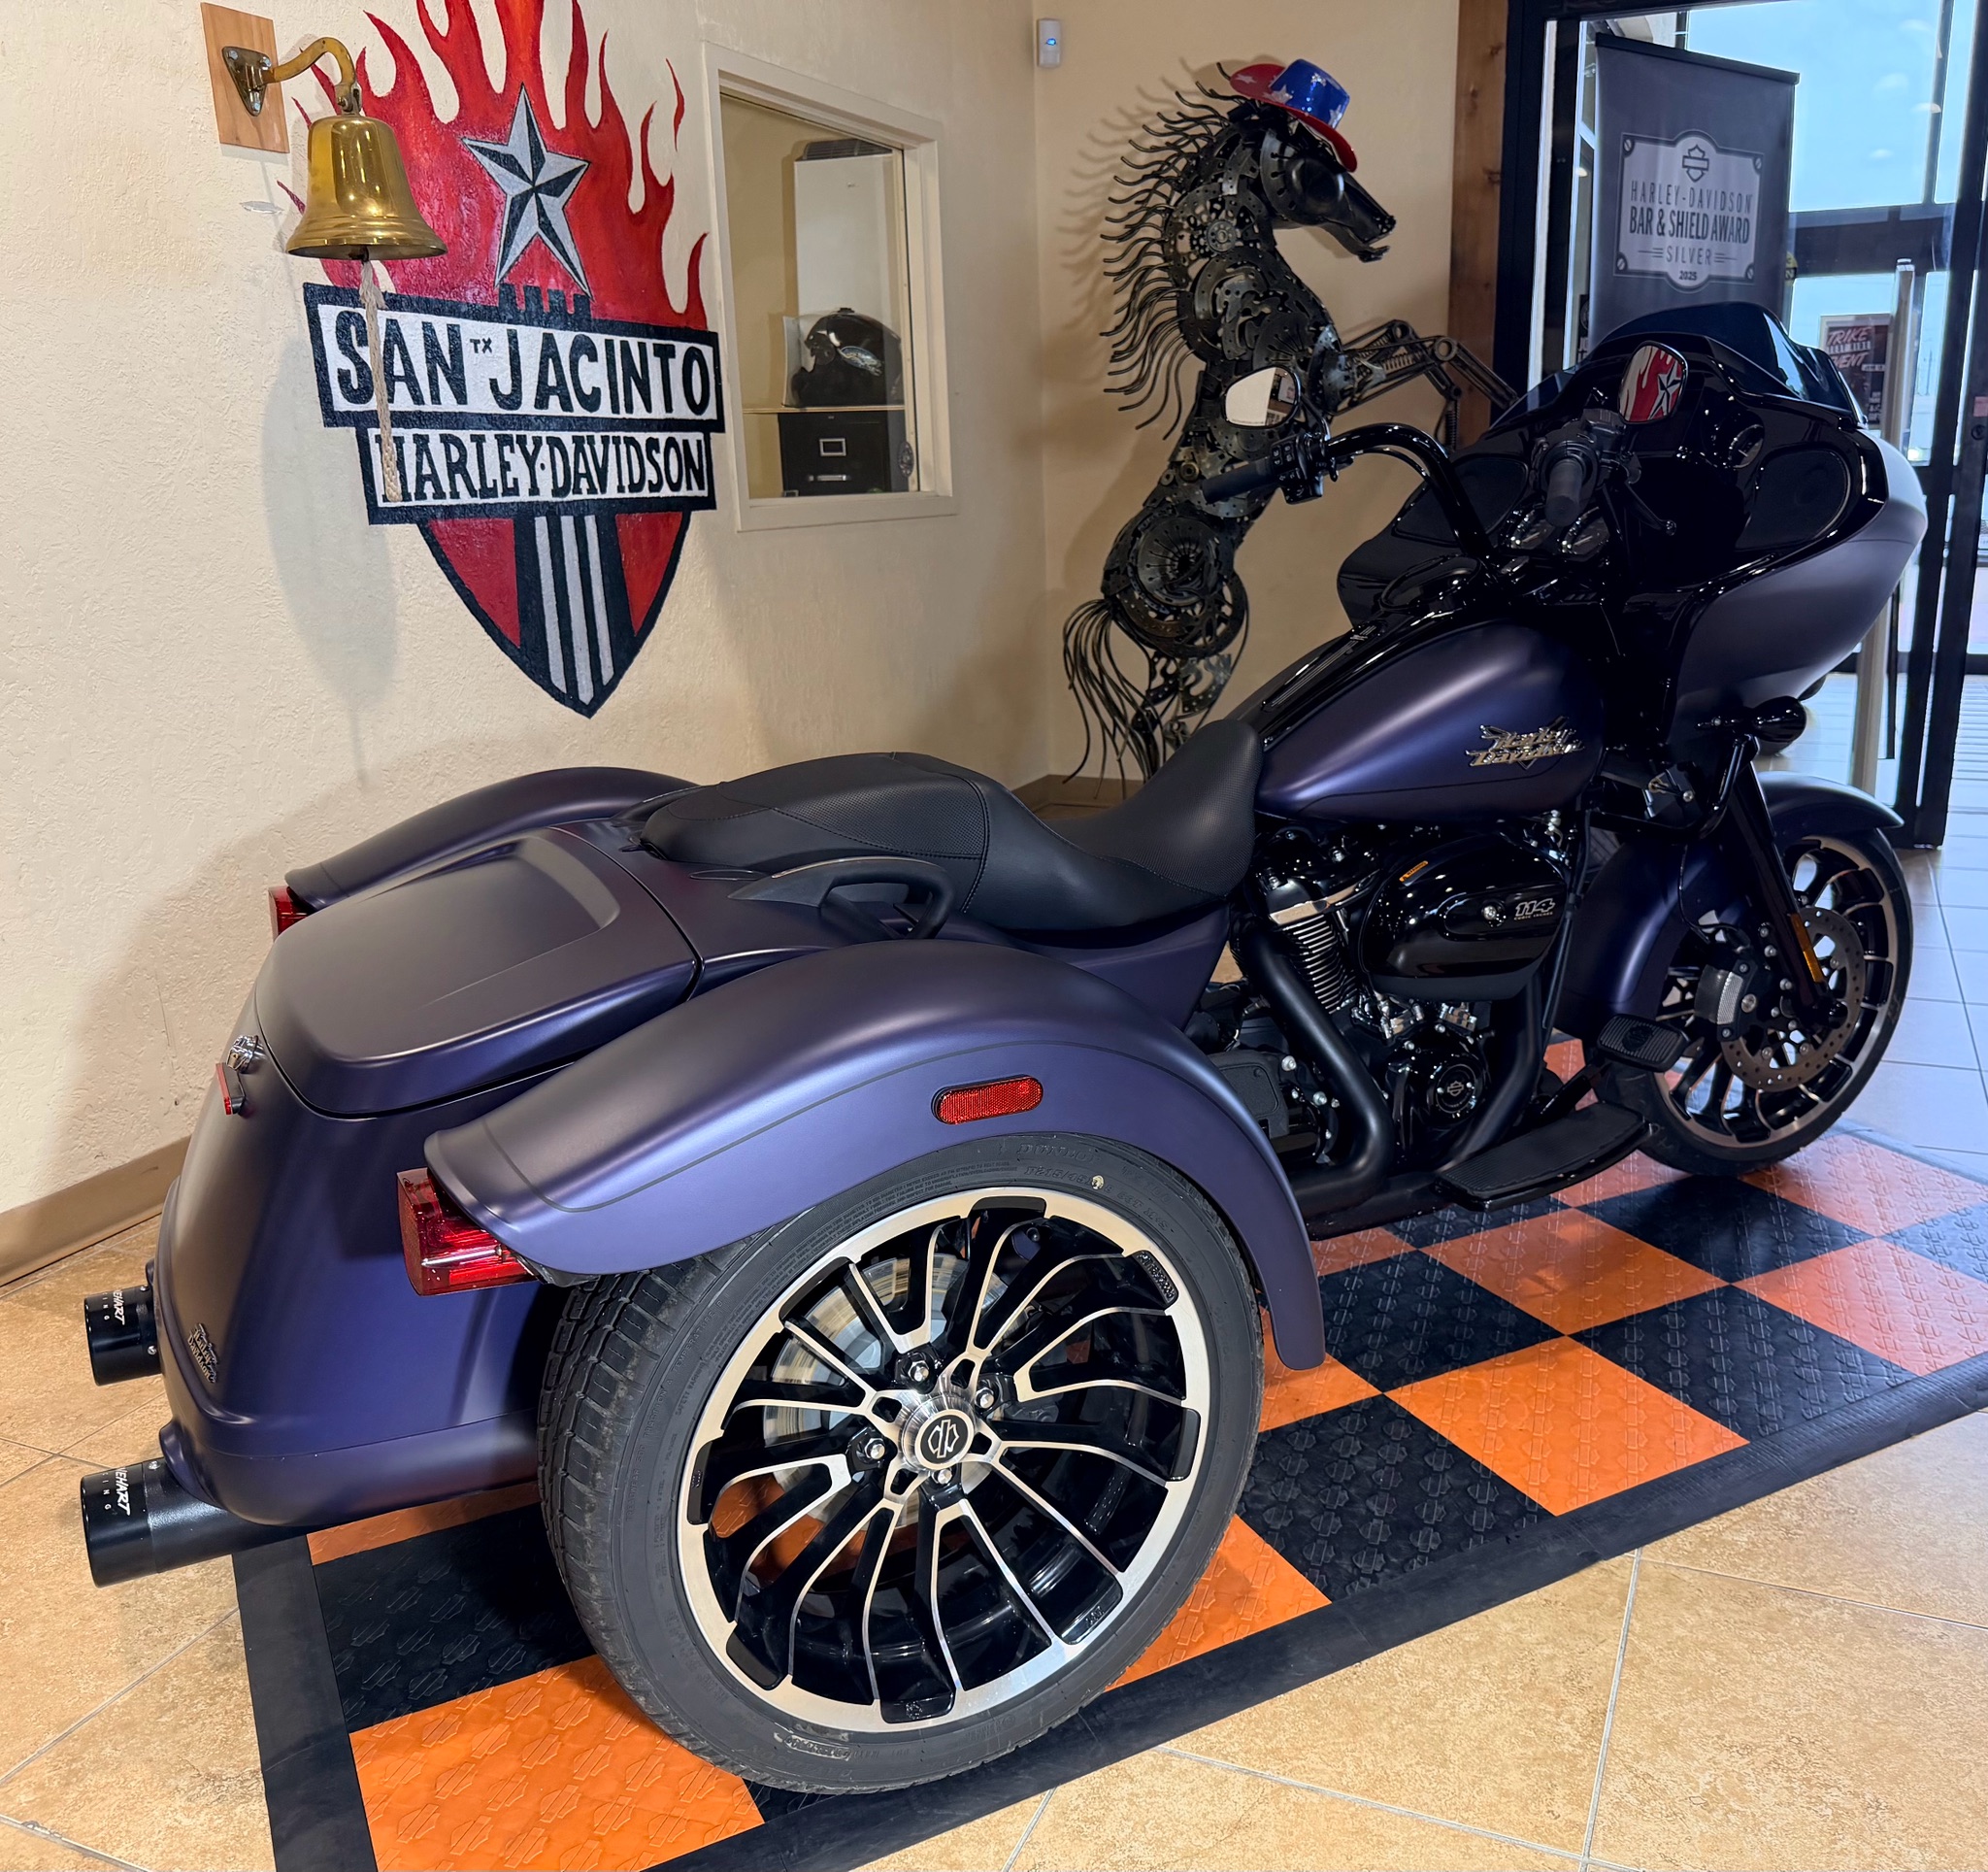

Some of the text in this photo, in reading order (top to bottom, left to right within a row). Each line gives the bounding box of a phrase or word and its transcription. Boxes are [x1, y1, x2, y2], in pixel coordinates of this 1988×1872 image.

[1631, 181, 1753, 215] HARLEY-DAVIDSON
[1629, 206, 1751, 244] BAR & SHIELD AWARD
[1666, 245, 1712, 266] SILVER
[1678, 270, 1698, 282] 2025
[1827, 326, 1872, 347] TRIKE
[335, 311, 710, 417] SAN TX JACINTO
[1831, 351, 1870, 369] VENT
[1514, 898, 1556, 917] 114
